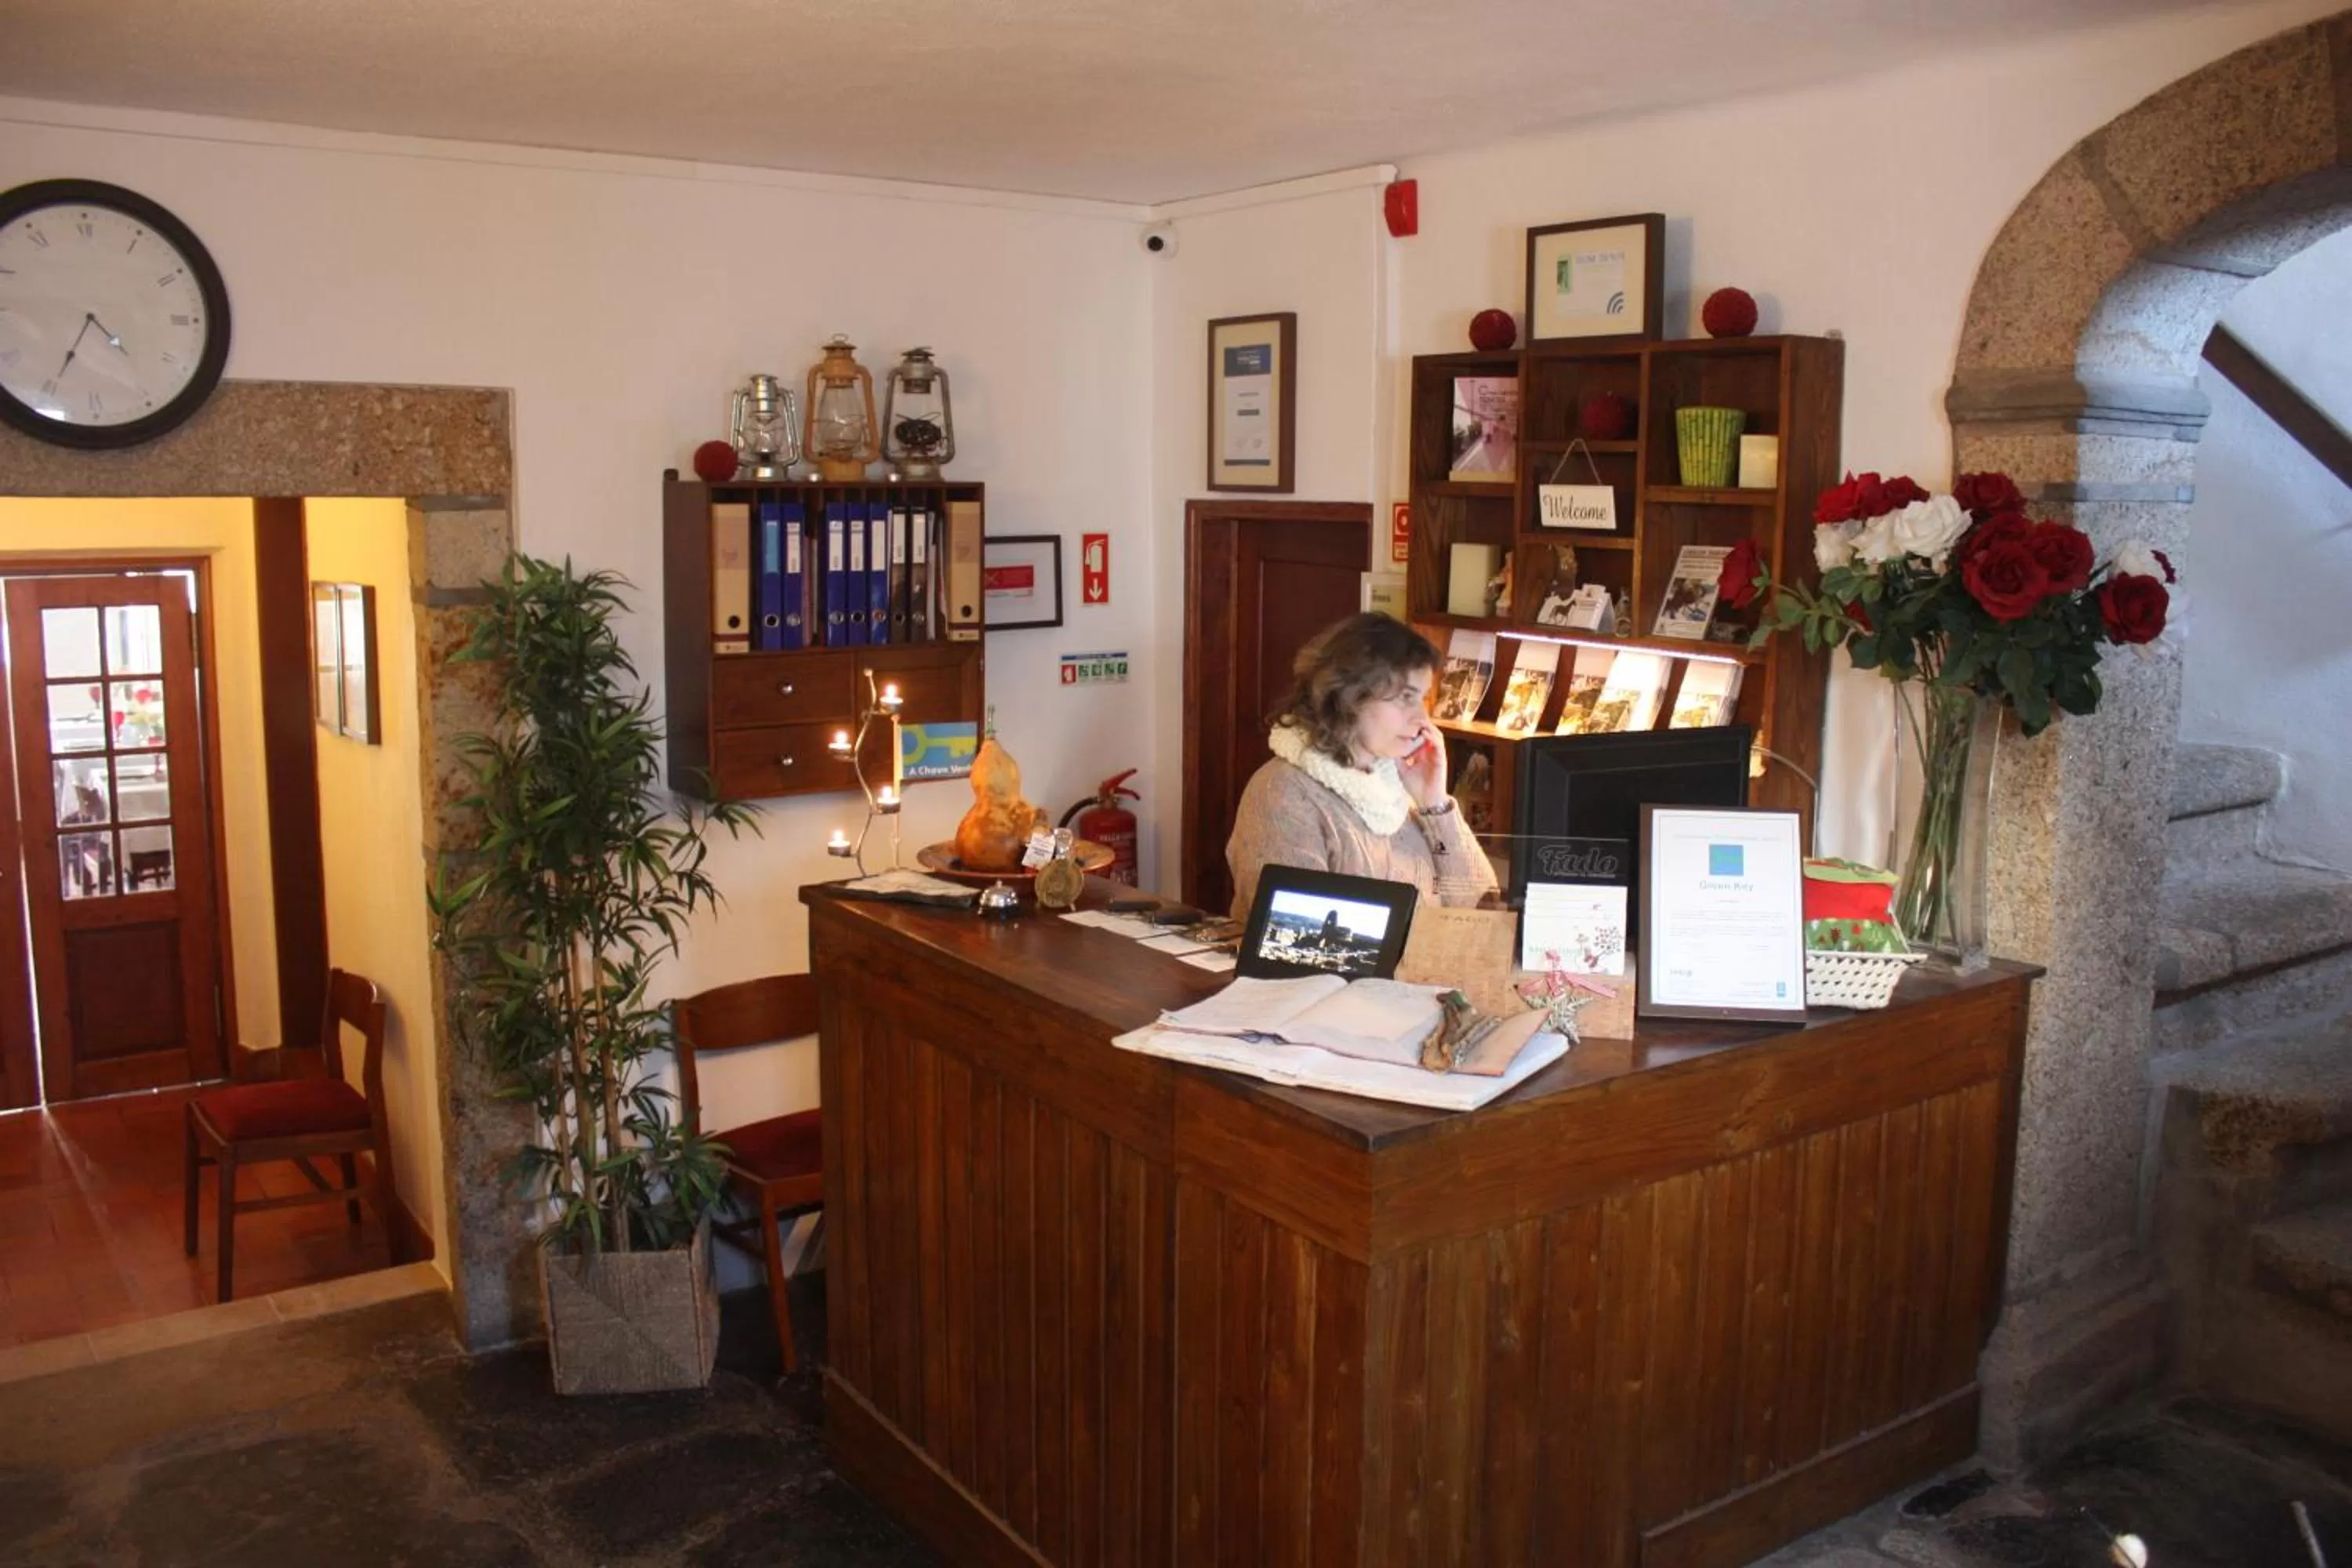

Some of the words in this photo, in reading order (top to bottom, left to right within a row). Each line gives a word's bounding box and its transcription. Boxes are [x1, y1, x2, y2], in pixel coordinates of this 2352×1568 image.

[1543, 493, 1607, 521] Welcome
[909, 767, 917, 775] A
[1537, 844, 1619, 876] Fado
